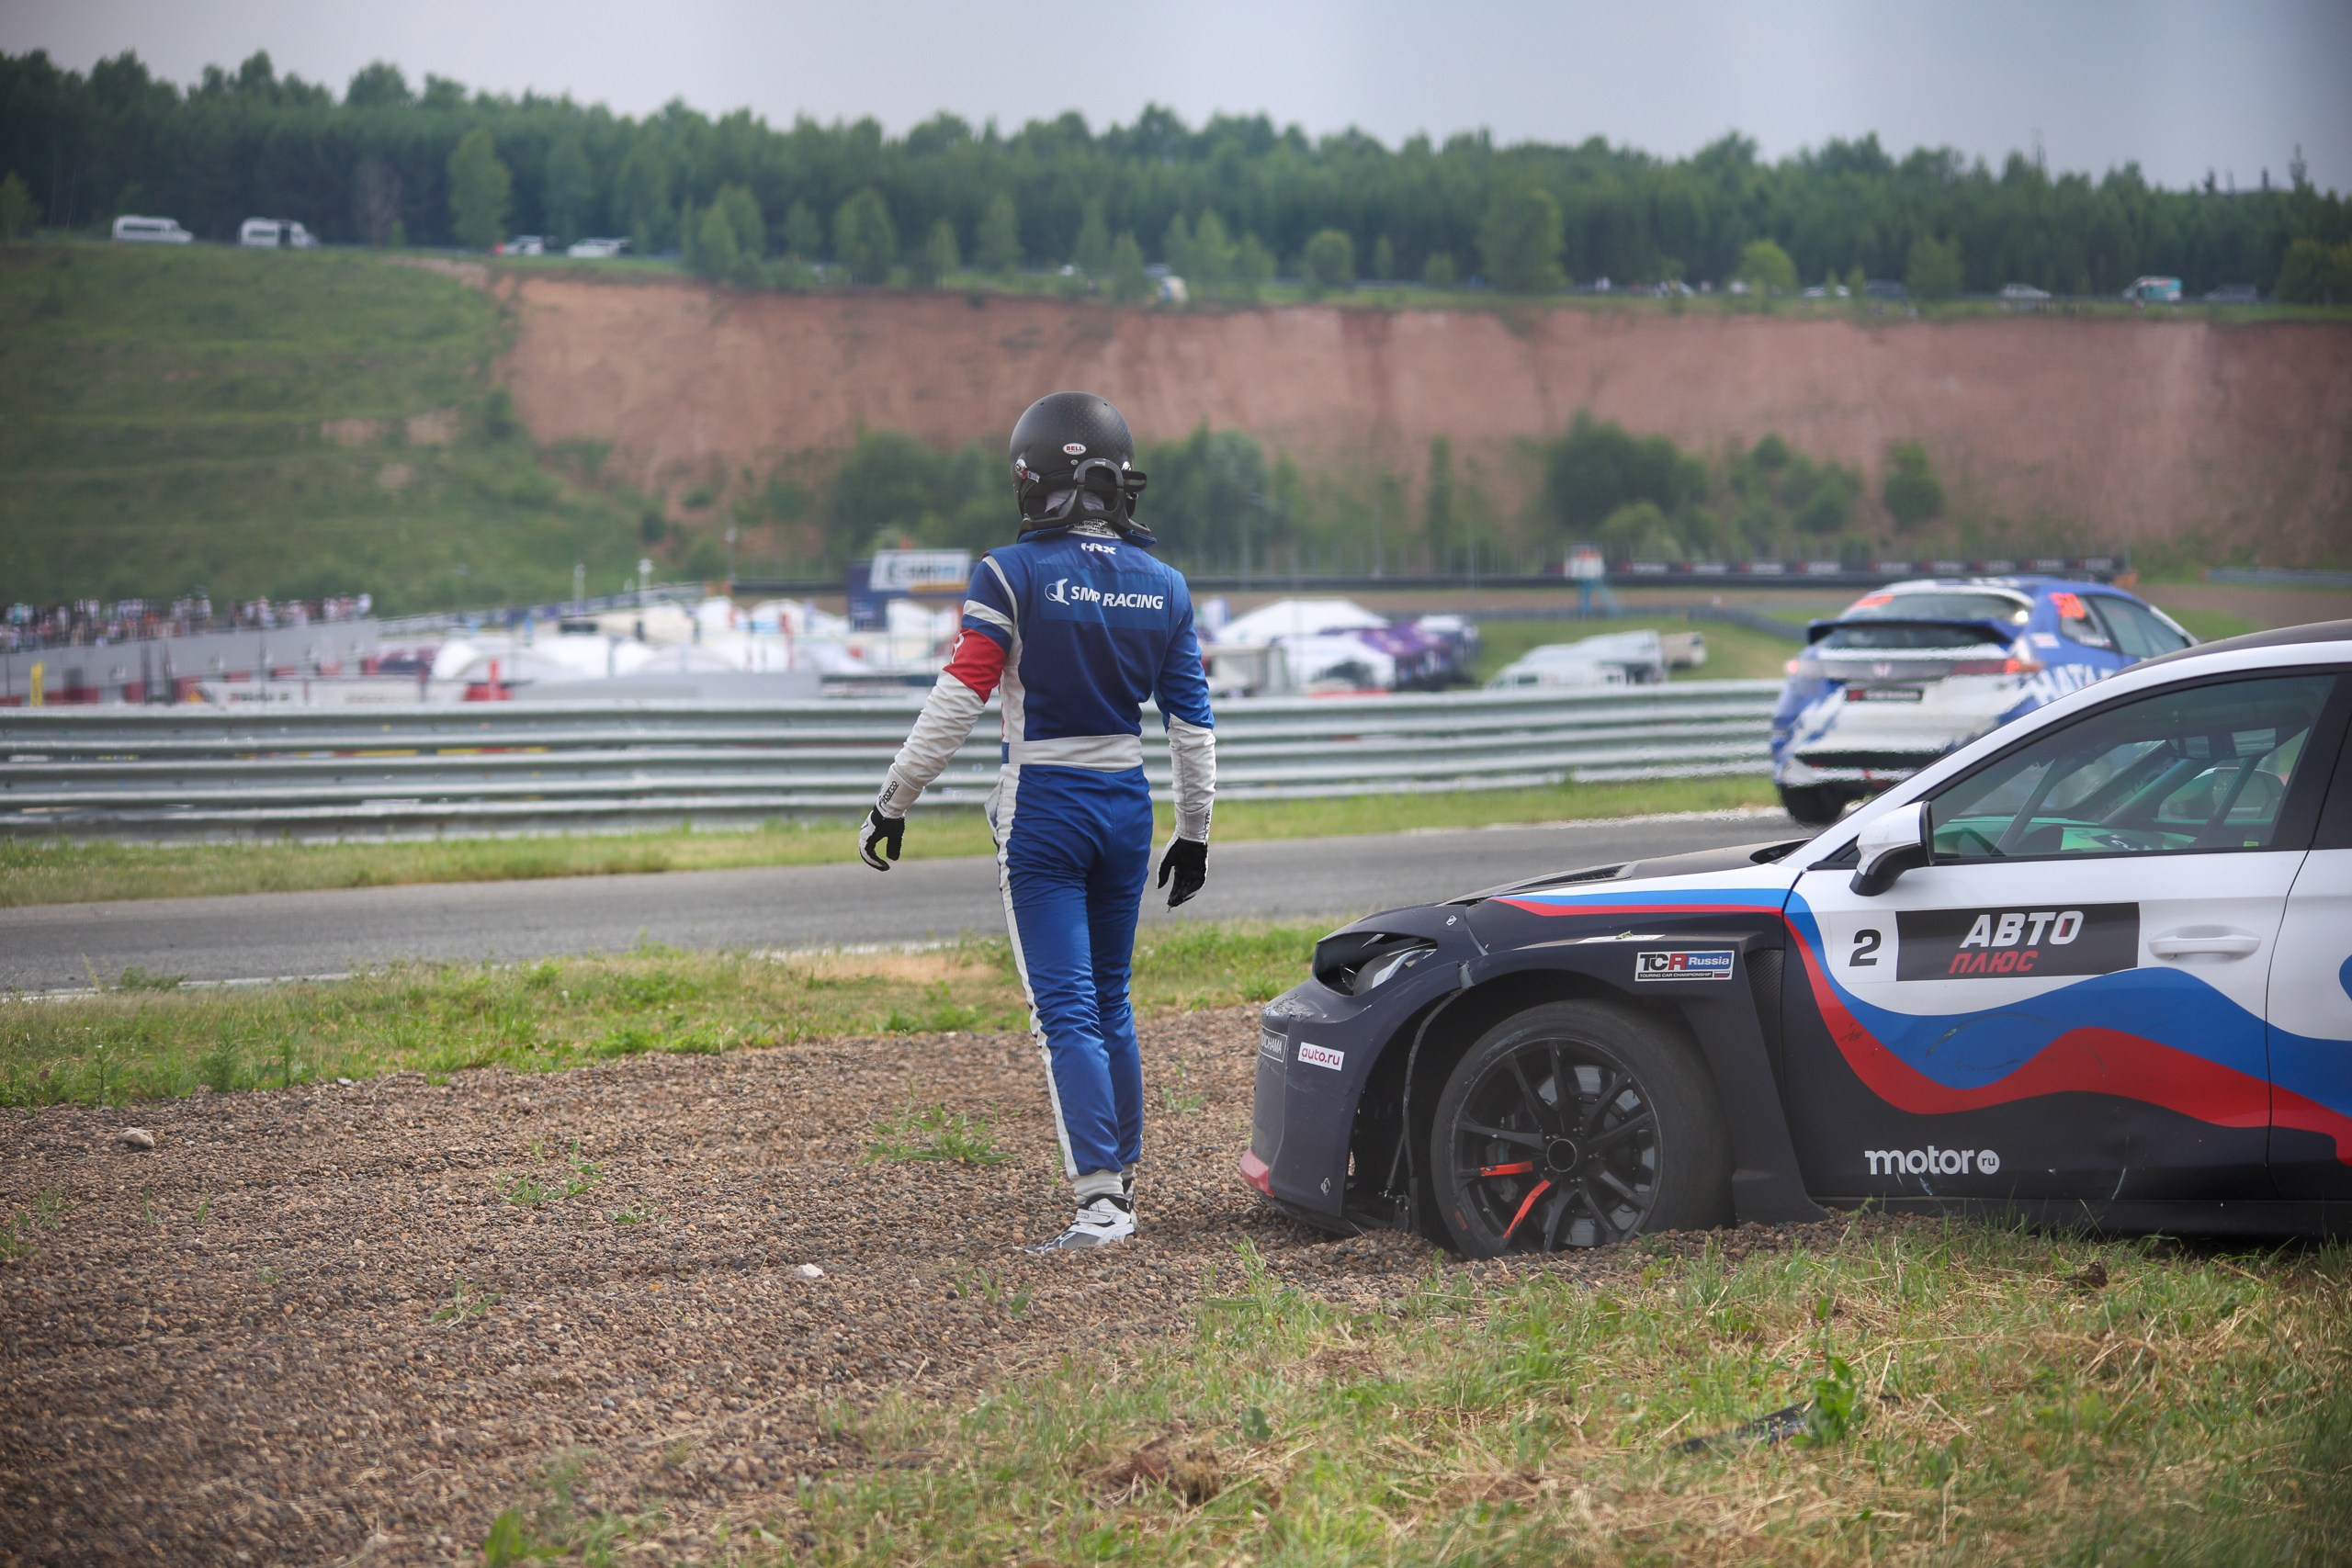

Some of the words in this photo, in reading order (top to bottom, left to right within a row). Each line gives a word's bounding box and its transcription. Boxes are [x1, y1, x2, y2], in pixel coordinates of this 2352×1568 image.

[1080, 542, 1117, 555] HRX
[1070, 585, 1101, 604] SMP
[1102, 592, 1164, 610] RACING
[1960, 909, 2085, 949] АВТО
[1849, 928, 1883, 967] 2
[1640, 953, 1688, 970] TCR
[1689, 956, 1730, 965] Russia
[1948, 950, 2039, 976] ПЛЮС
[1301, 1047, 1340, 1066] auto.ru
[1864, 1145, 1975, 1176] motor
[1982, 1157, 1996, 1167] ru
